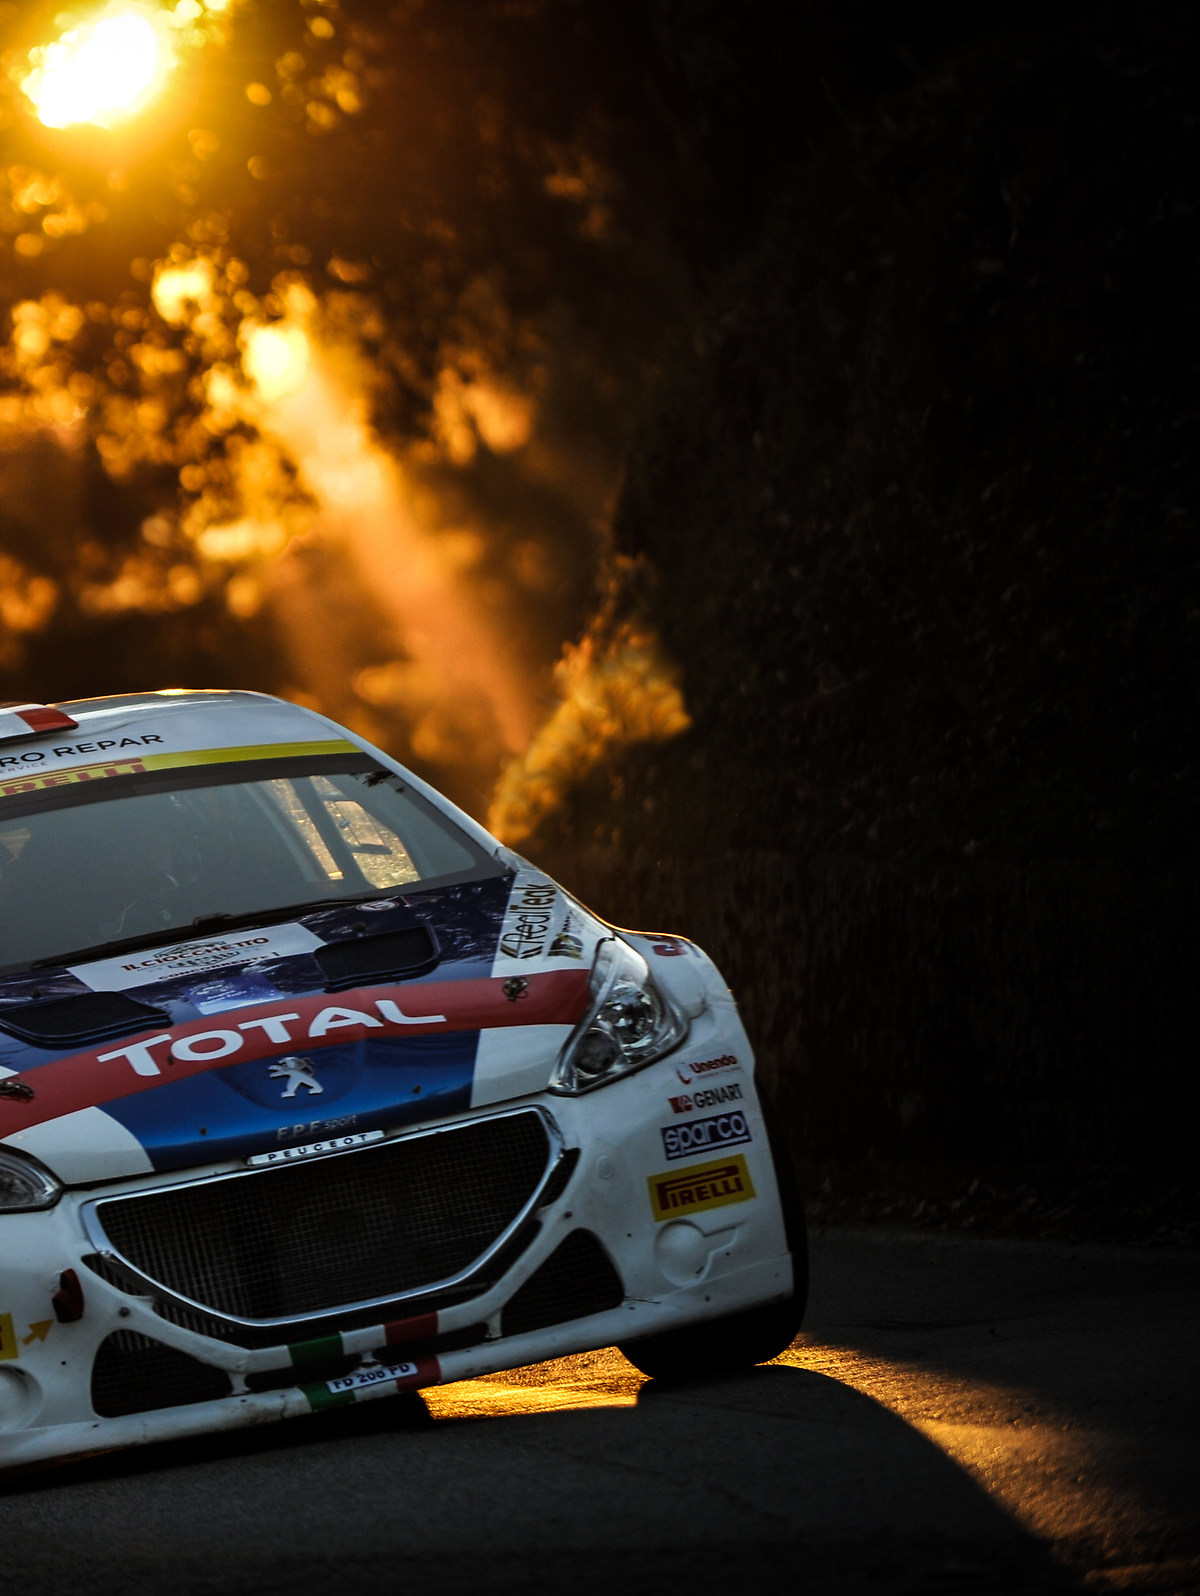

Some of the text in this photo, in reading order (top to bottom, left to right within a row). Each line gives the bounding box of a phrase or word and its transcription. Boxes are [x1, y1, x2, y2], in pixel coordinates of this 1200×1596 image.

[52, 734, 164, 758] REPAR
[140, 937, 270, 967] CIOCCHETTO
[97, 1000, 447, 1077] TOTAL
[689, 1054, 738, 1074] Unendo
[693, 1083, 743, 1108] GENART
[268, 1134, 366, 1161] PEUGEOT
[664, 1114, 746, 1156] sparco
[656, 1164, 745, 1211] PIRELLI
[333, 1377, 354, 1389] FD
[356, 1369, 386, 1383] 208
